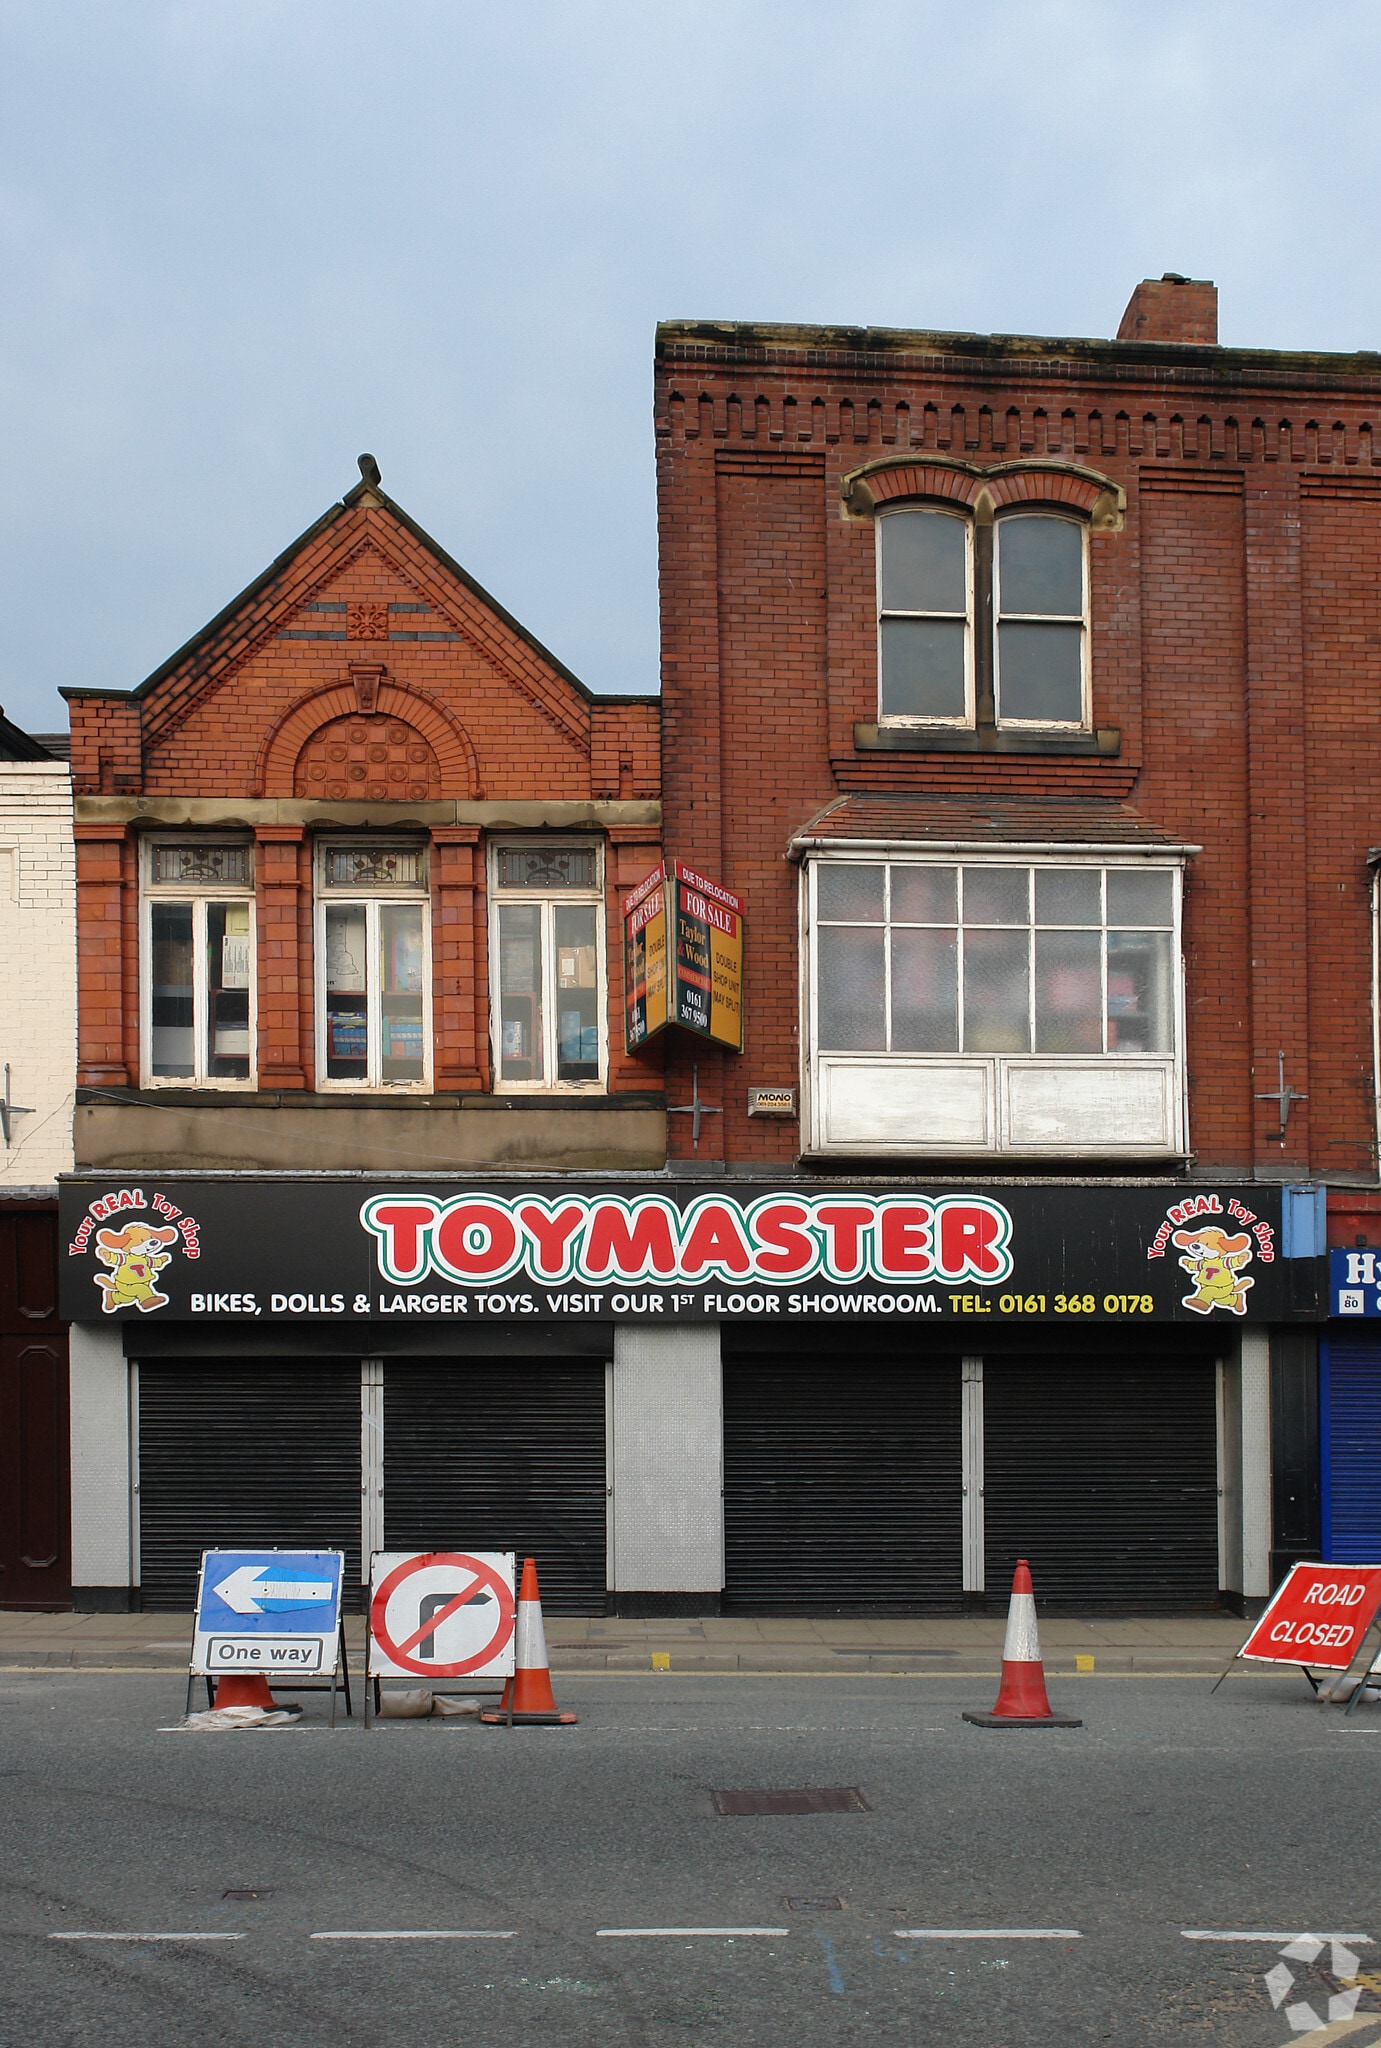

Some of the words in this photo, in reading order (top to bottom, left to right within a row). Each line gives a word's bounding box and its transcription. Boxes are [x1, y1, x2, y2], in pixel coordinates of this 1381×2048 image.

[682, 868, 695, 884] DUE
[695, 875, 704, 888] TO
[704, 880, 739, 909] RELOCATION
[631, 908, 644, 934] FOR
[643, 892, 660, 923] SALE
[687, 891, 707, 920] FOR
[708, 904, 732, 933] SALE
[680, 918, 706, 945] Taylor
[677, 939, 685, 957] &
[685, 943, 709, 968] Wood
[715, 952, 737, 973] DOUBLE
[713, 970, 728, 987] SHOP
[686, 990, 702, 1008] 0161
[681, 1004, 692, 1021] 367
[757, 1093, 791, 1102] MONO
[69, 1217, 96, 1256] Your
[90, 1189, 147, 1220] REAL
[152, 1193, 182, 1220] Toy
[178, 1218, 200, 1259] Shop
[1148, 1222, 1174, 1259] Your
[1168, 1195, 1223, 1225] REAL
[1228, 1199, 1257, 1225] Toy
[1252, 1222, 1274, 1262] Shop
[366, 1198, 1007, 1280] TOYMASTER
[190, 1293, 262, 1316] BIKES,
[271, 1293, 345, 1313] DOLLS
[352, 1293, 371, 1313] &
[379, 1293, 468, 1313] LARGER
[473, 1293, 540, 1313] TOYS.
[546, 1293, 604, 1313] VISIT
[610, 1293, 664, 1313] OUR
[703, 1293, 781, 1313] FLOOR
[787, 1293, 943, 1313] SHOWROOM.
[948, 1293, 991, 1313] TEL:
[999, 1293, 1046, 1313] 0161
[1053, 1293, 1096, 1313] 368
[1103, 1293, 1154, 1313] 0178
[1344, 1299, 1359, 1308] 80
[1303, 1583, 1366, 1606] ROAD
[1270, 1620, 1355, 1647] CLOSED
[218, 1645, 262, 1660] One
[270, 1648, 313, 1664] way
